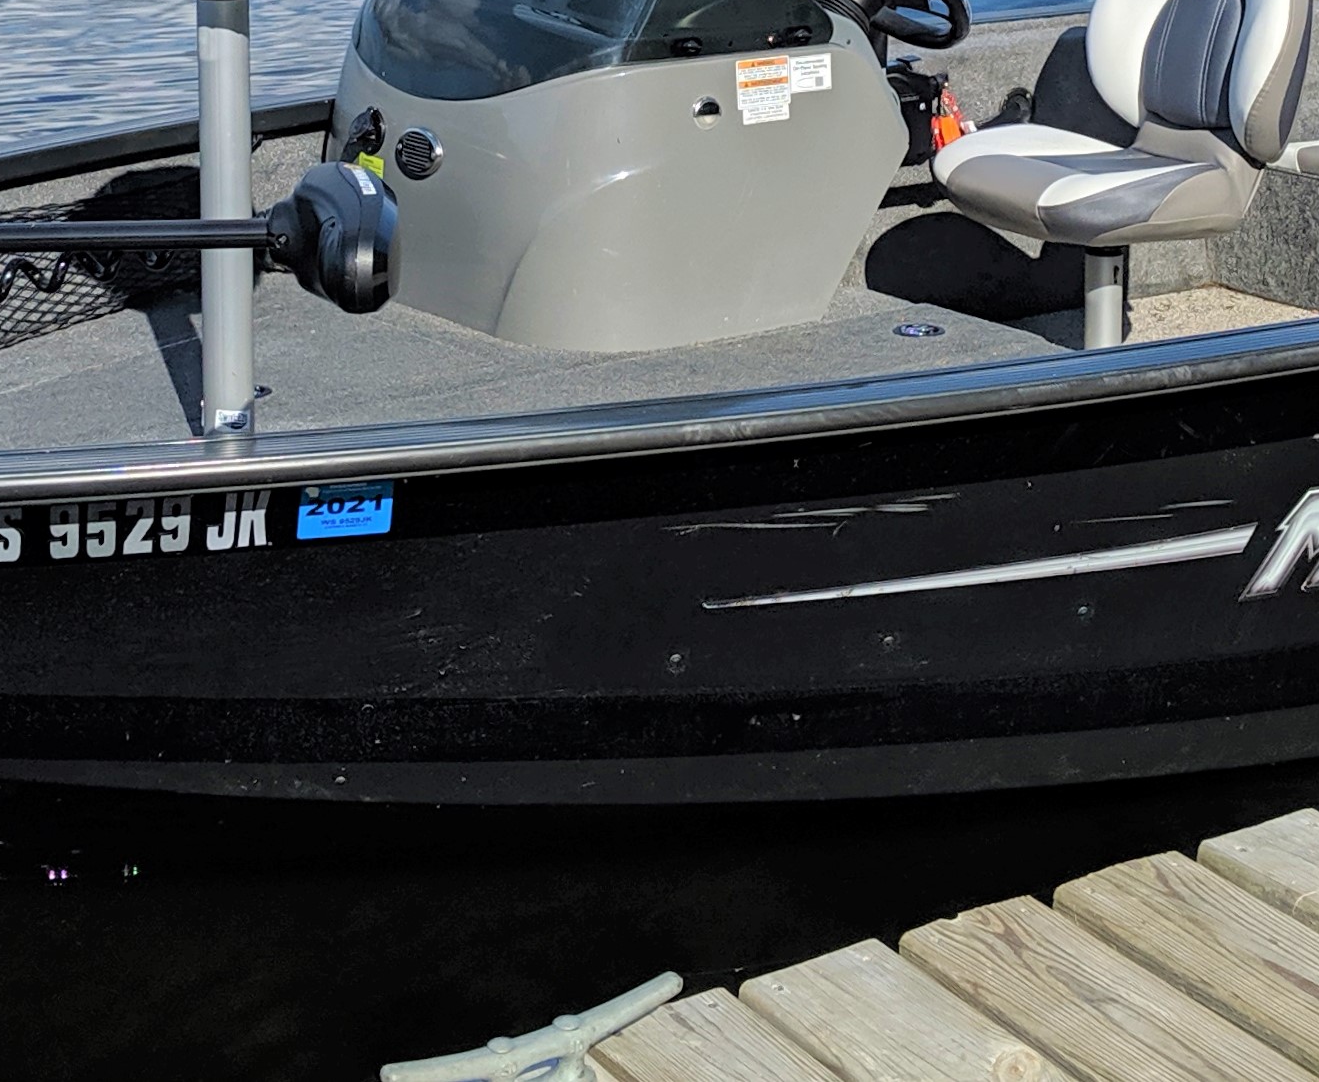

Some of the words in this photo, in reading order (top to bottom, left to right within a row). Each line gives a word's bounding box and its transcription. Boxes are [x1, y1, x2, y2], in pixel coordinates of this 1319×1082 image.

[47, 494, 193, 560] 9529
[205, 489, 272, 552] JK
[305, 493, 384, 517] 2021
